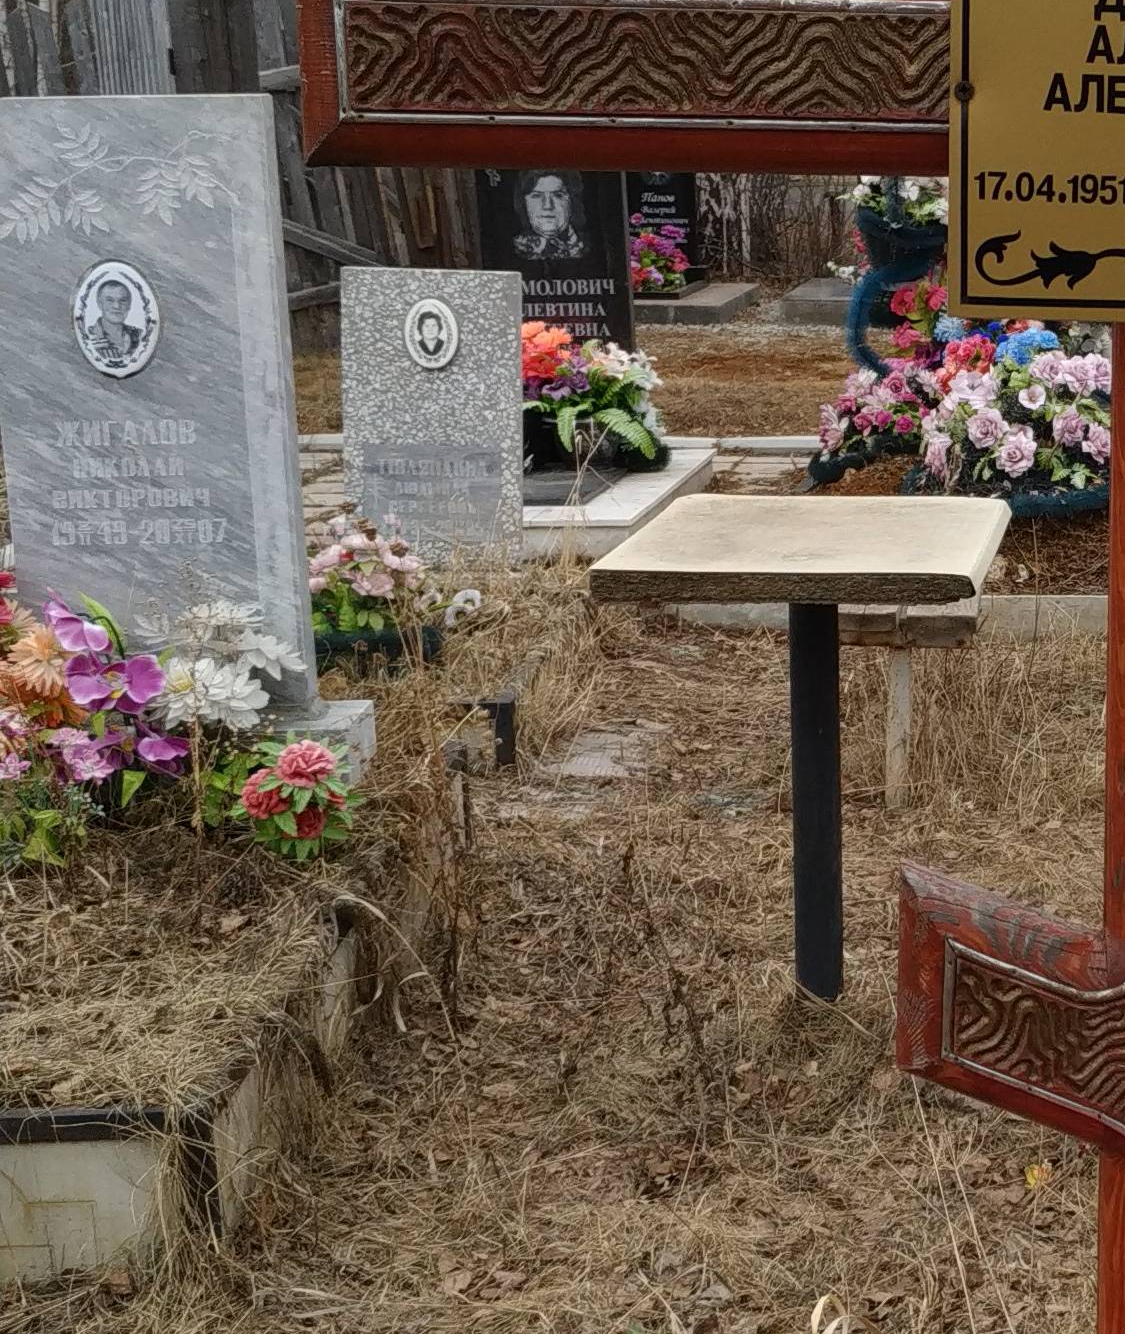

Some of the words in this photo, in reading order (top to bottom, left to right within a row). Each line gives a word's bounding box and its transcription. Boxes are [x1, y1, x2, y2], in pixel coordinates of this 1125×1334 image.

[521, 278, 616, 296] МОЛОВИЧ
[521, 302, 607, 318] ЛЕВТИНА
[54, 419, 197, 447] ЖИГАЛОВ
